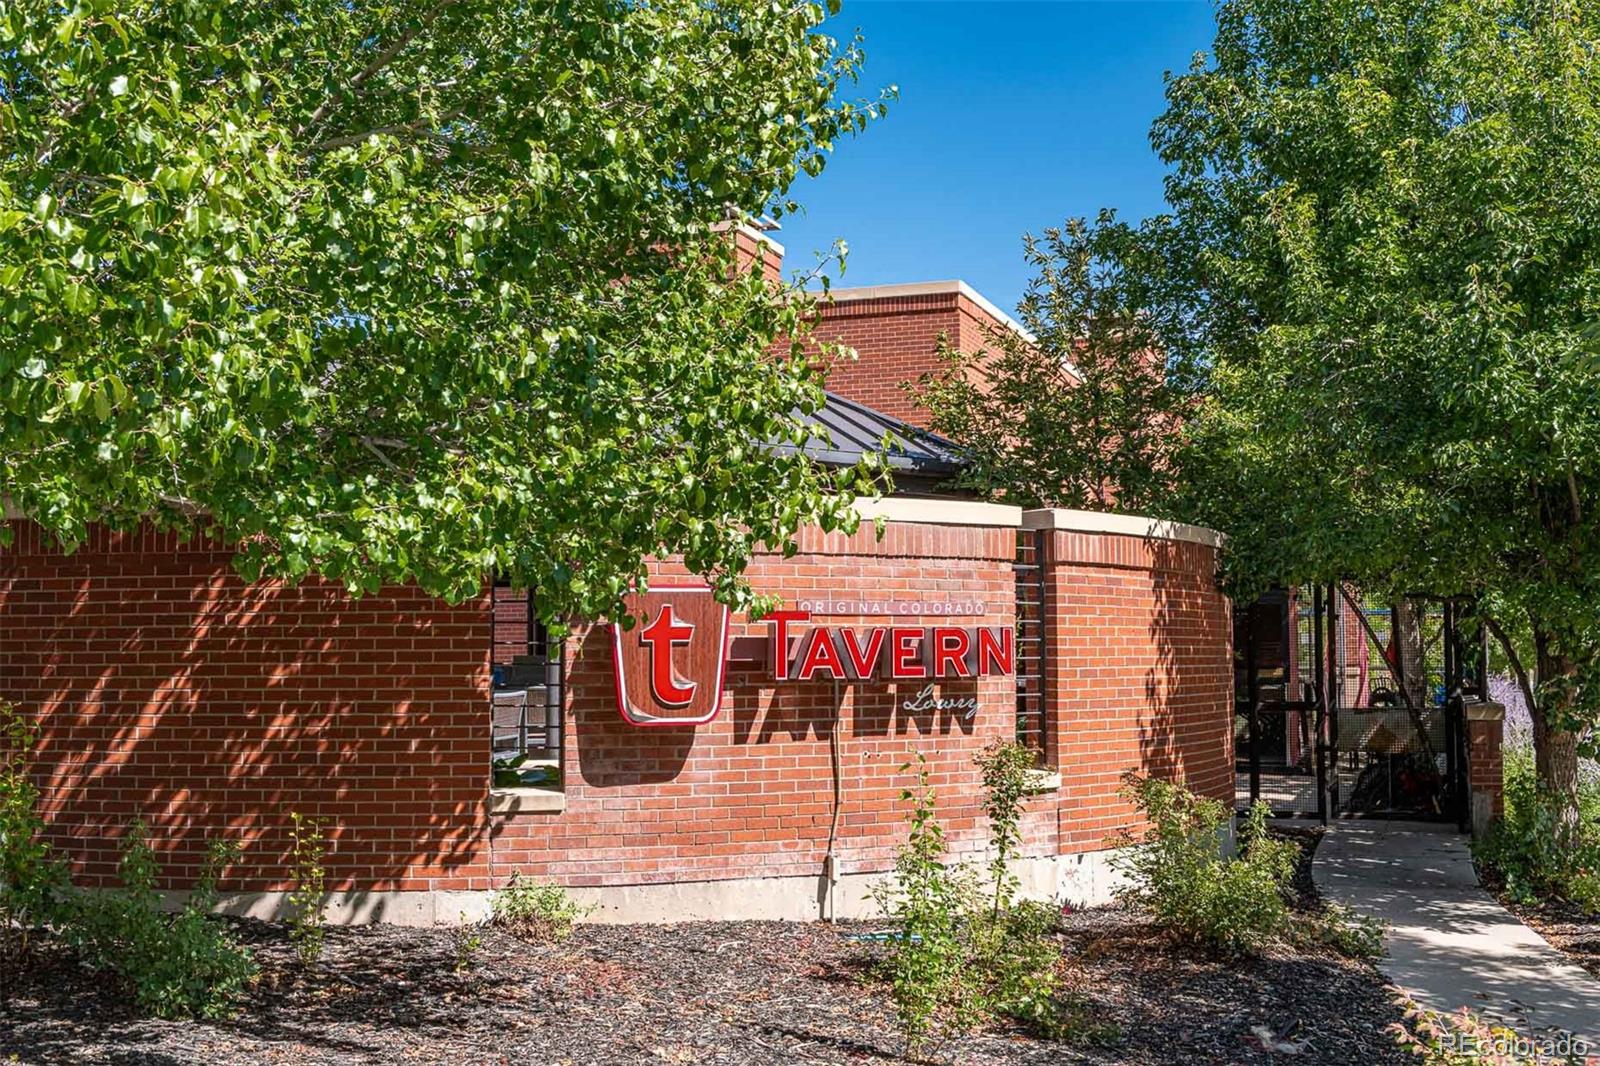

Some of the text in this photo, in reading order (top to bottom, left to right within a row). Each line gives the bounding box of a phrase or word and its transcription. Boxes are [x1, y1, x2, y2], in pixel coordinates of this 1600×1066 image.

[800, 600, 985, 616] ORIGINAL COLORADO
[640, 604, 698, 706] t
[761, 610, 1014, 681] TAVERN
[902, 683, 983, 720] Lowry
